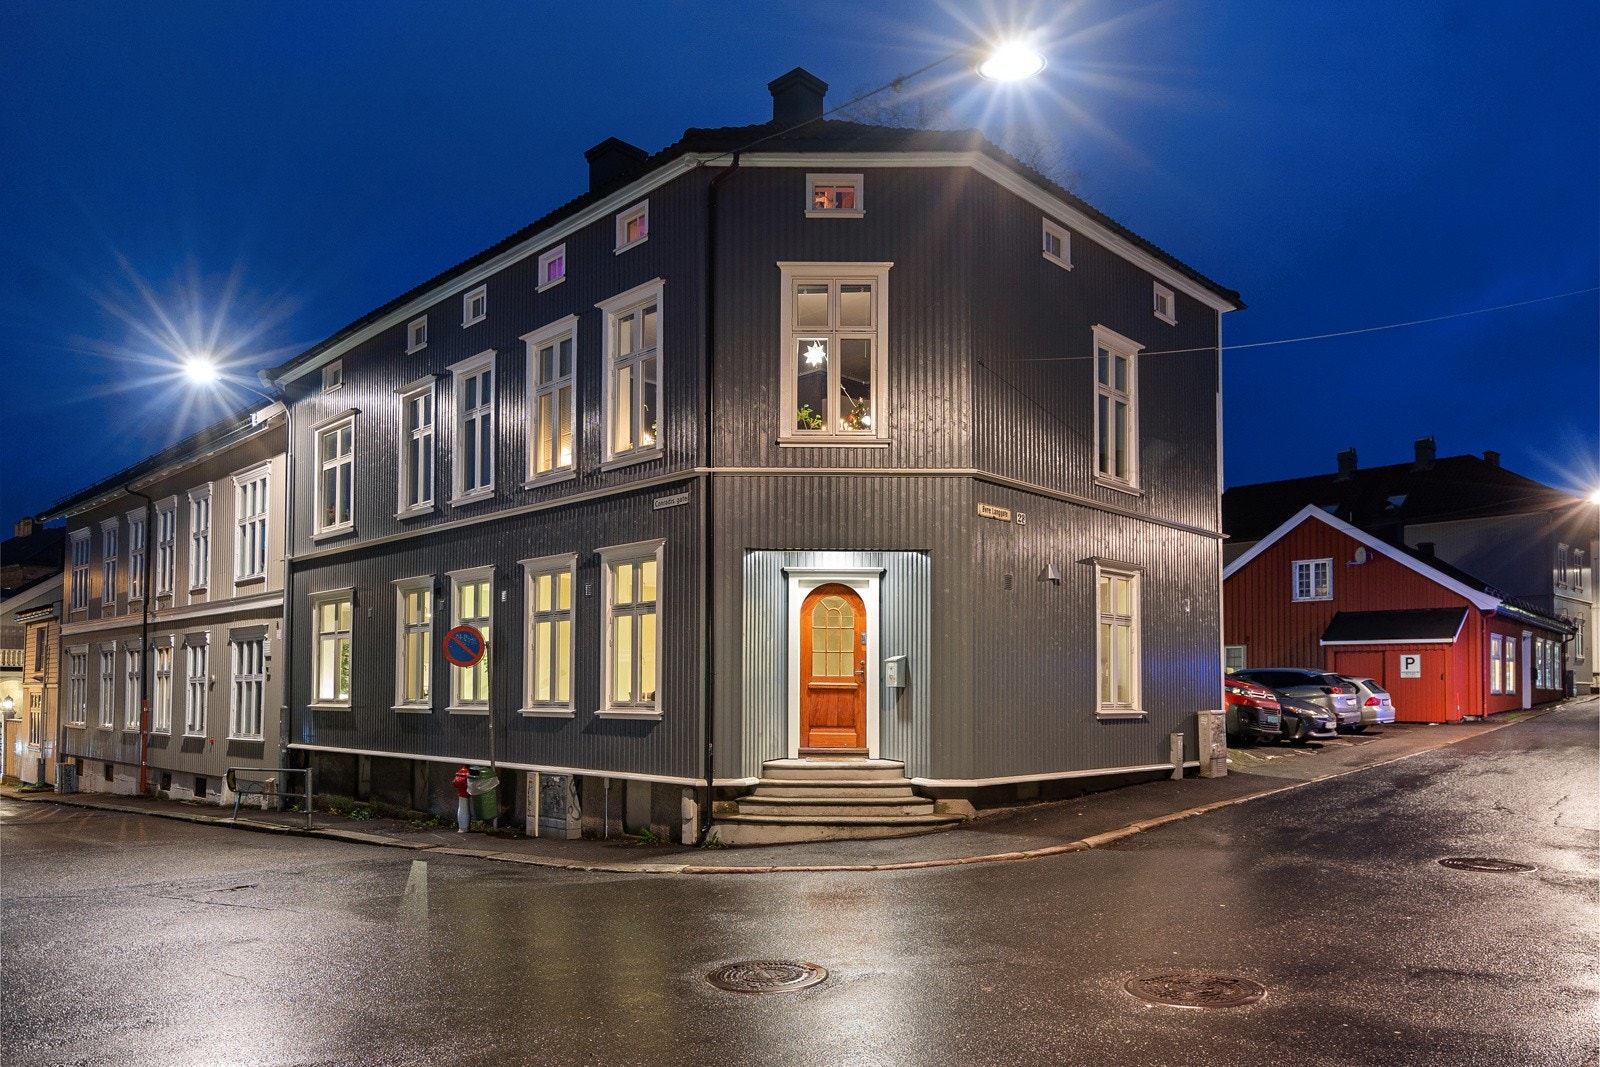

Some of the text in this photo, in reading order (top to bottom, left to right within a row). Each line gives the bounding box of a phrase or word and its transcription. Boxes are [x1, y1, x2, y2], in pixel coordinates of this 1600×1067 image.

[655, 496, 688, 507] Conradis gate
[1405, 656, 1416, 670] P
